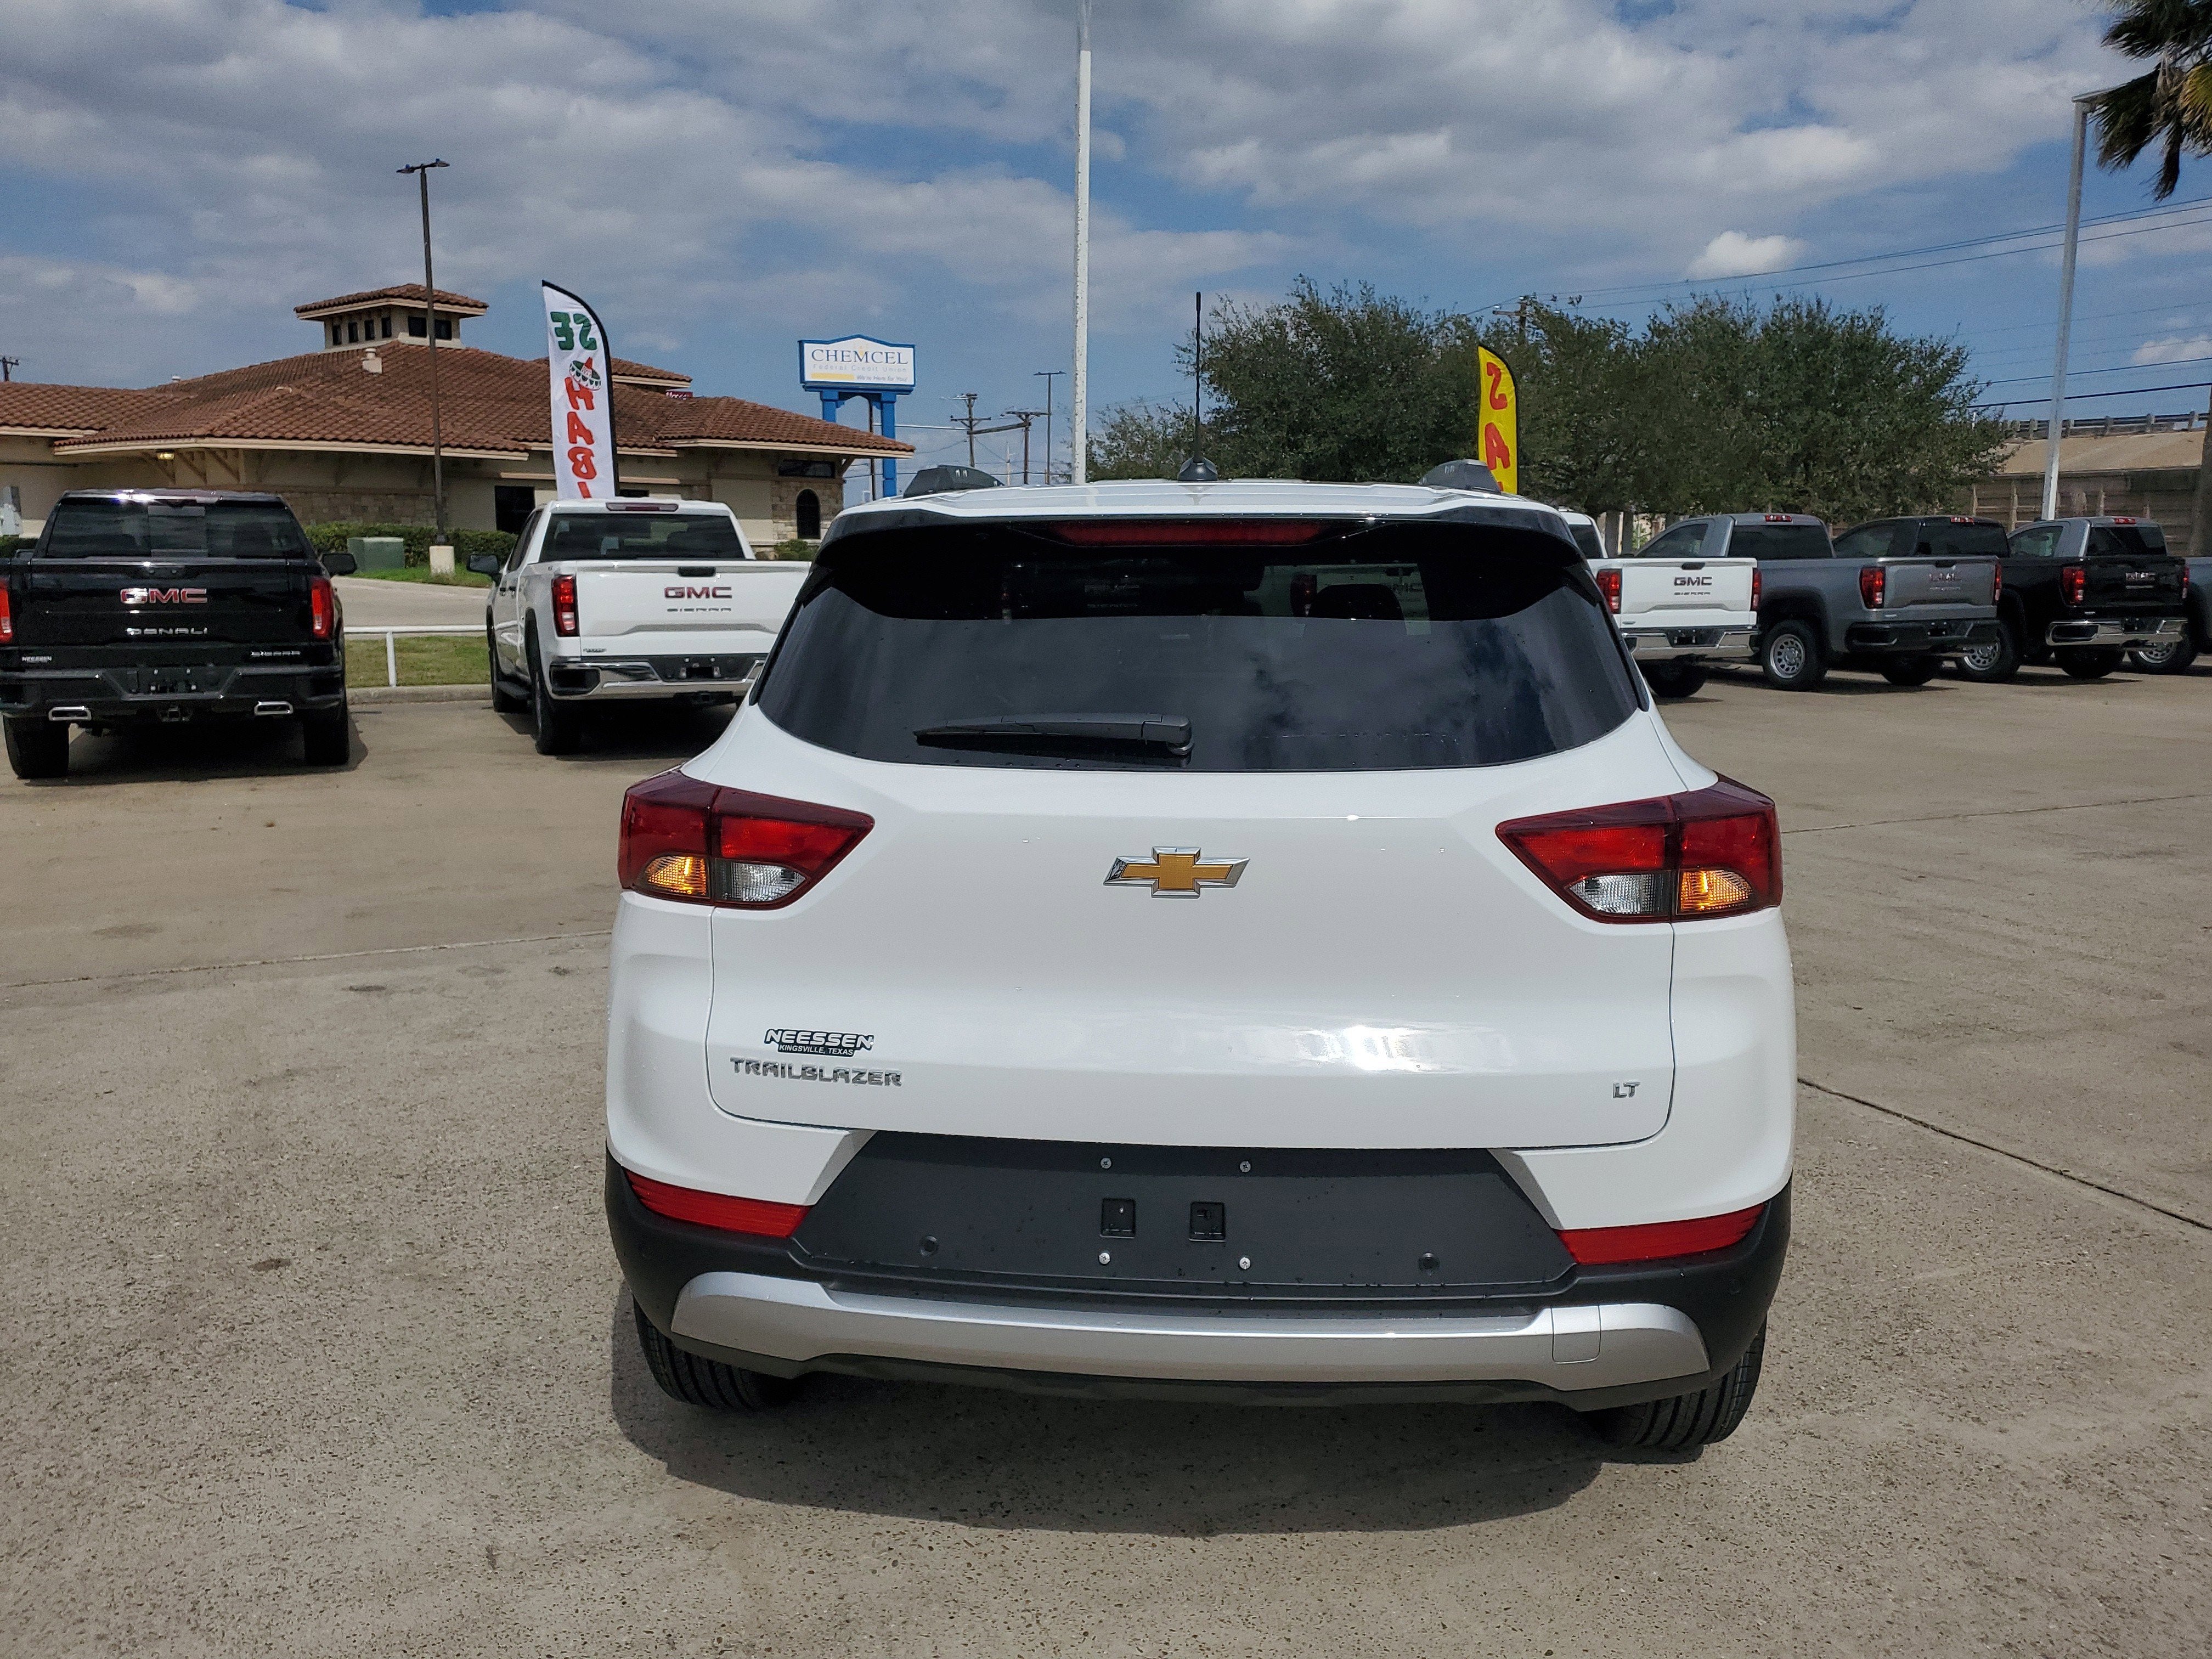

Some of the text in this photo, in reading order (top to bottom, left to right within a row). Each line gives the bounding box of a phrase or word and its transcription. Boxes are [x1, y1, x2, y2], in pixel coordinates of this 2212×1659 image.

[811, 349, 909, 364] CHEMCEL
[1674, 577, 1712, 586] GMC
[120, 588, 208, 604] GMC
[664, 586, 732, 599] GMC
[126, 627, 208, 635] DENALI
[765, 1029, 874, 1050] NEESSEN
[778, 1044, 854, 1056] KINGSVILLE, TEXAS
[730, 1057, 902, 1087] TRAILBLAZER
[1613, 1081, 1640, 1098] LT
